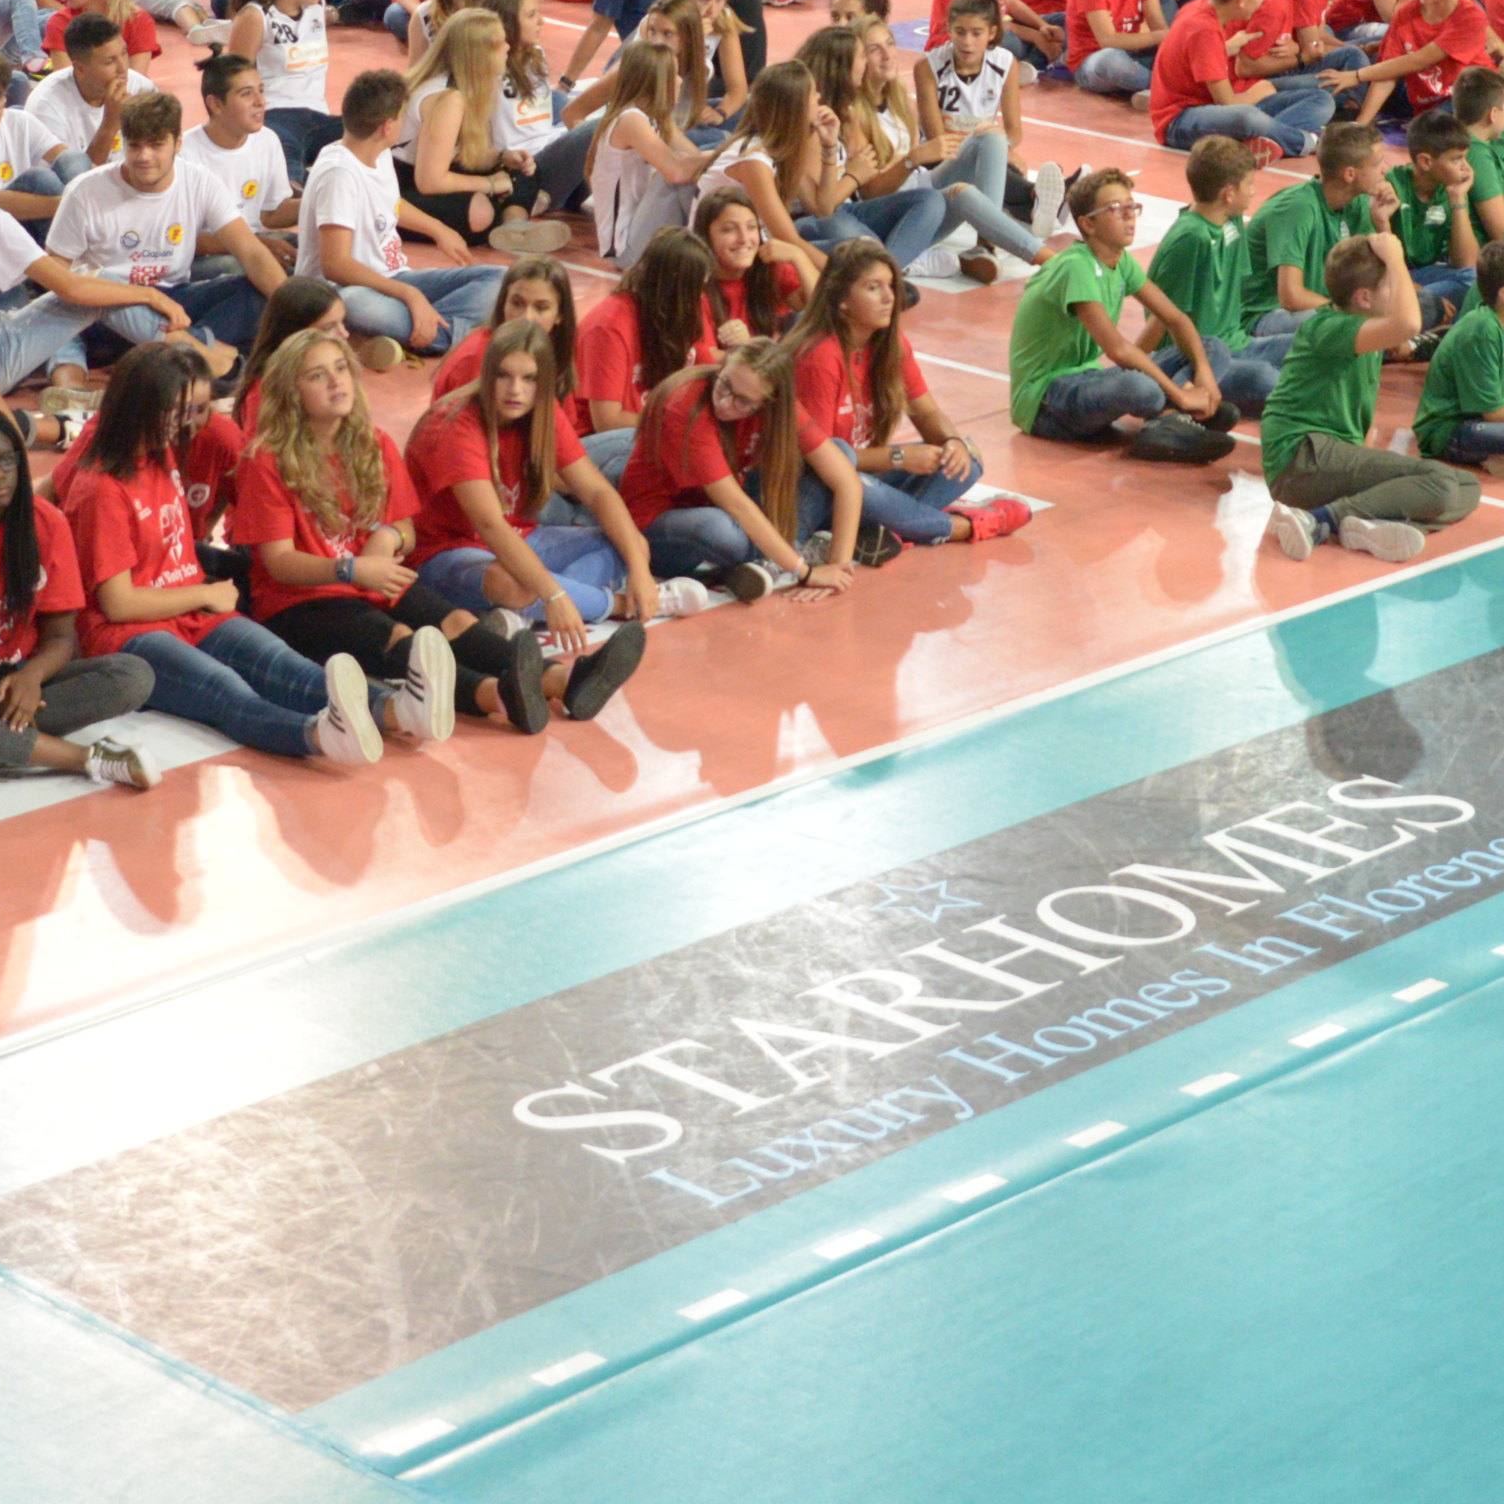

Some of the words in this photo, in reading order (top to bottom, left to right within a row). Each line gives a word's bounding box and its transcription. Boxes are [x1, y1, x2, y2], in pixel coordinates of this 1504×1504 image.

[271, 20, 299, 44] 28
[937, 86, 961, 113] 12
[512, 773, 1476, 1166] STARHOMES
[644, 1071, 978, 1212] Luxury
[941, 959, 1233, 1087] Homes
[1202, 920, 1304, 981] In
